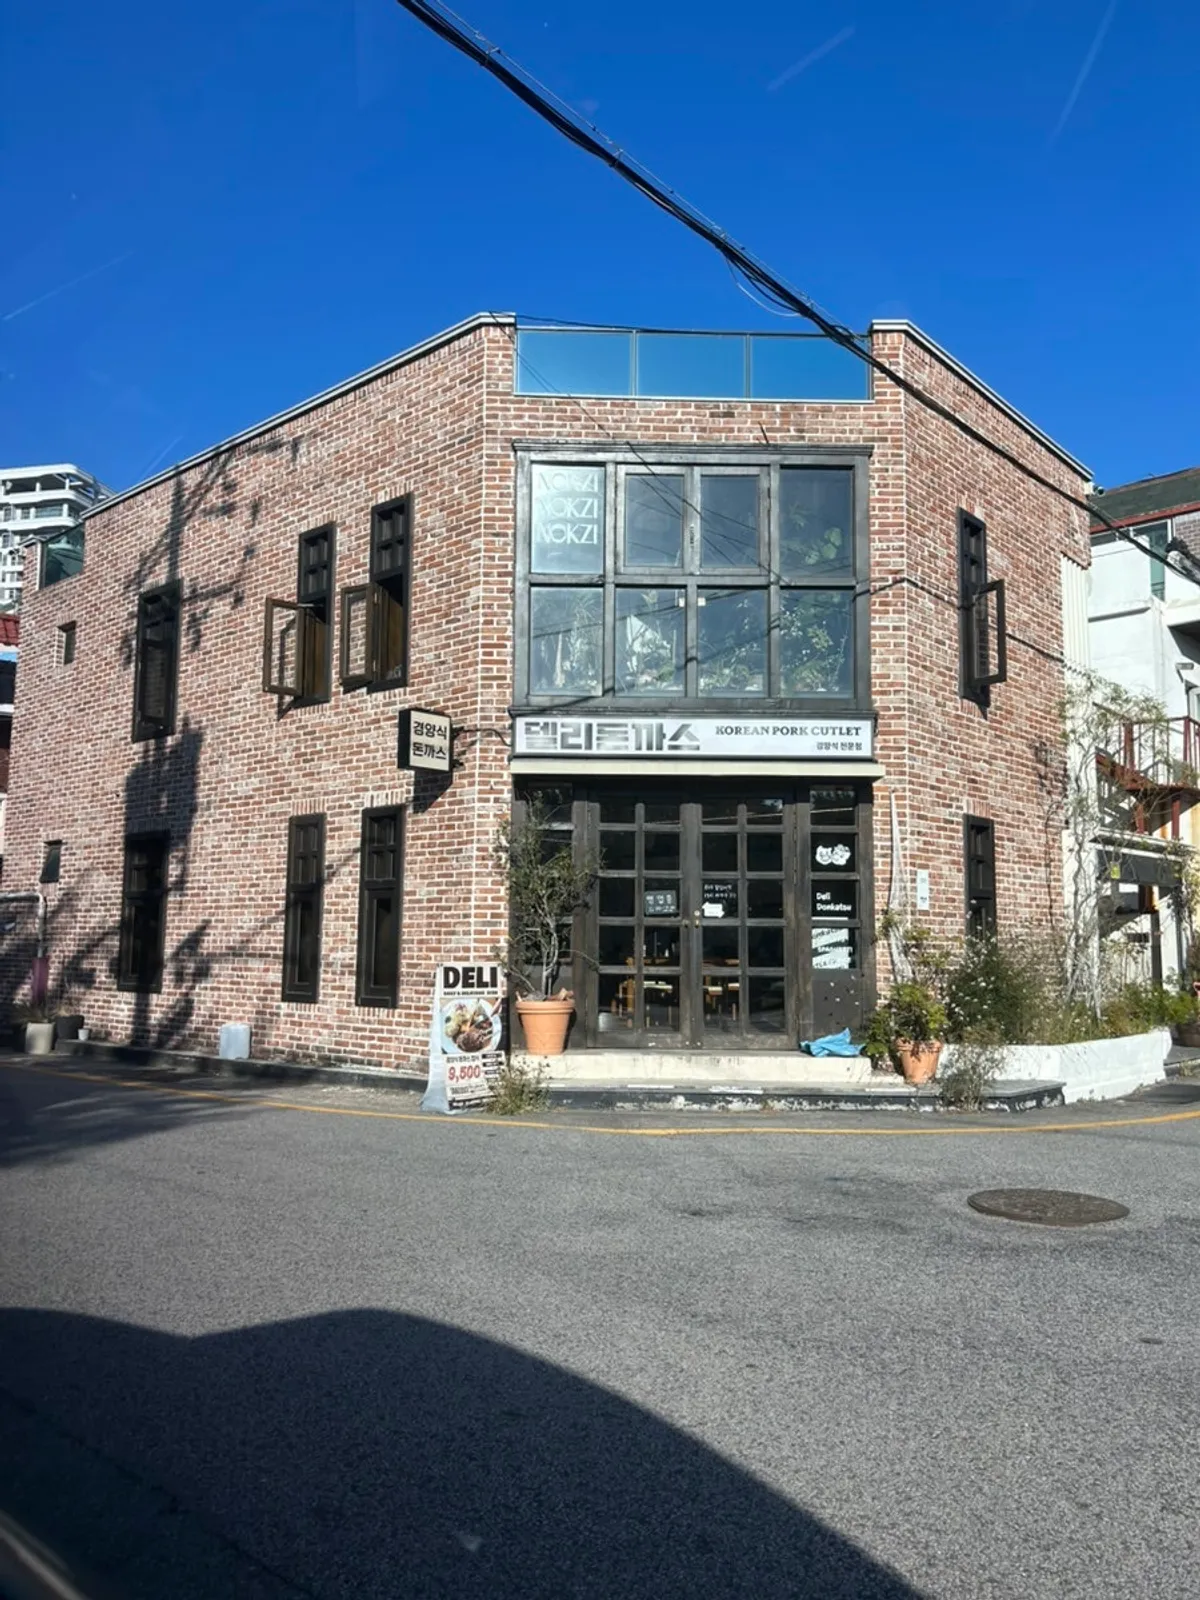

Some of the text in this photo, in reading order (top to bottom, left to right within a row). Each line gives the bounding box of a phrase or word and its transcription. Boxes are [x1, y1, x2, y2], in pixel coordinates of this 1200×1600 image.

[537, 497, 599, 519] NOKZI
[537, 523, 599, 545] NOKZI
[413, 720, 447, 740] 경양식
[524, 721, 700, 751] 델리돈까스
[715, 725, 862, 737] KOREAN PORK CUTLET
[412, 742, 447, 760] 돈까스
[443, 966, 498, 988] DELI
[448, 1065, 481, 1083] 9,500
